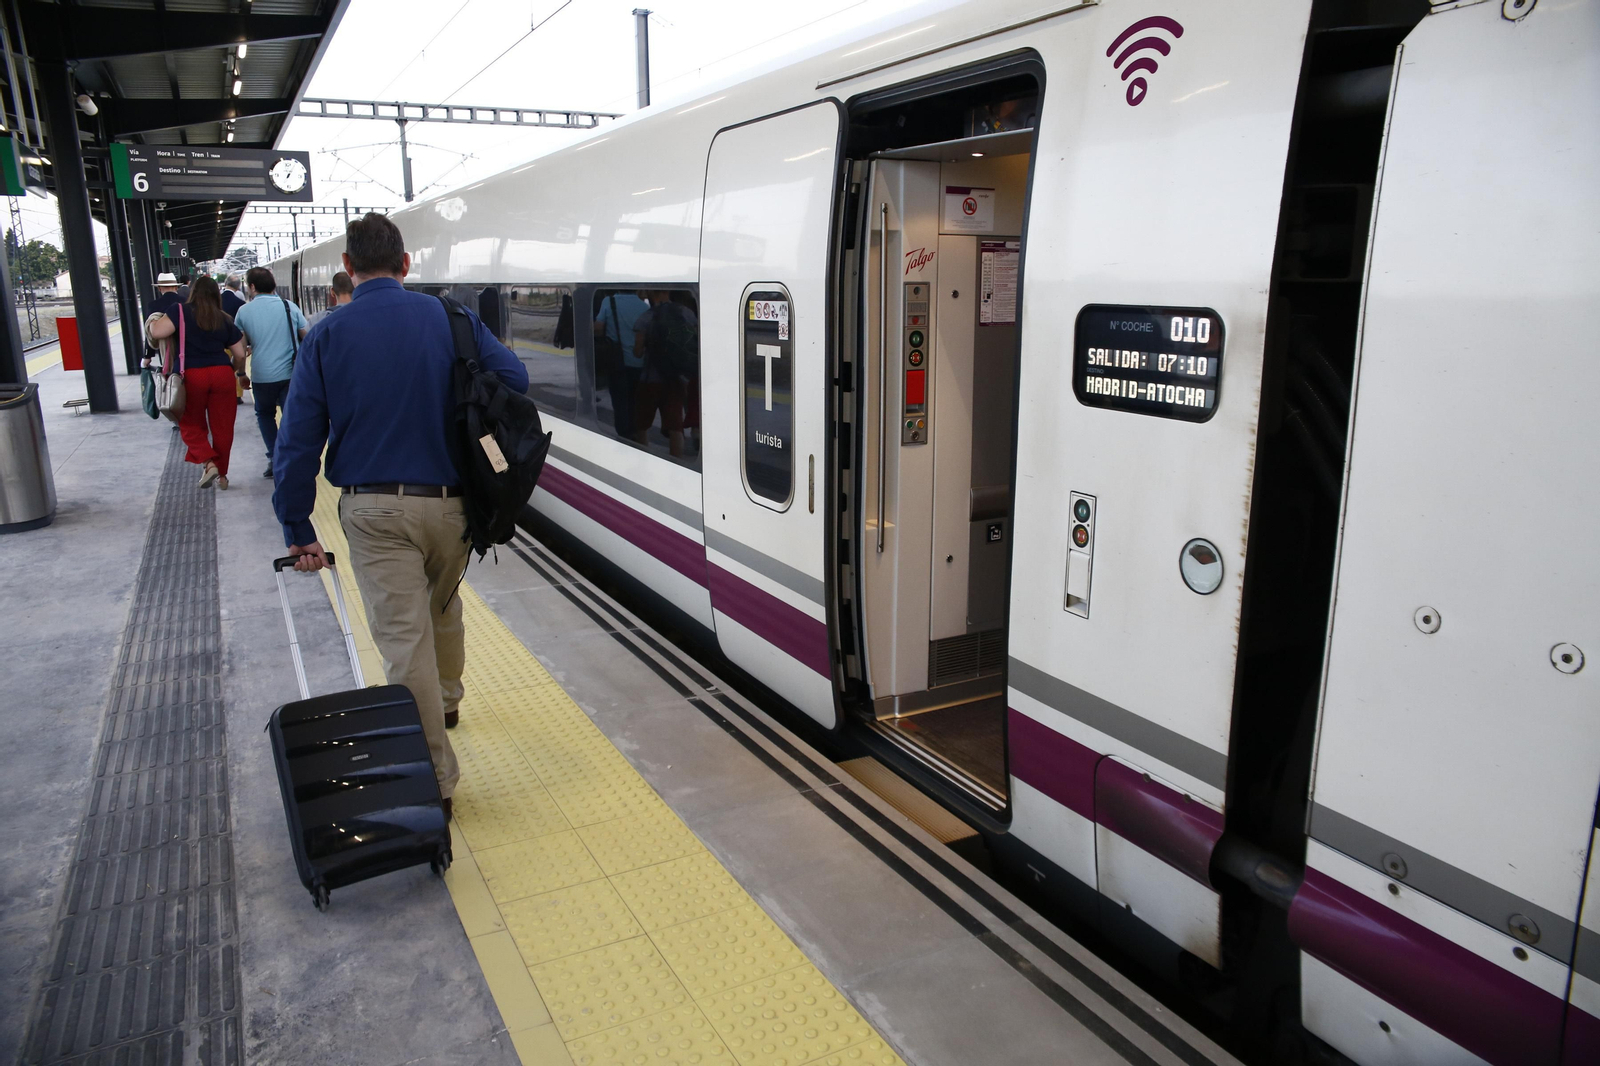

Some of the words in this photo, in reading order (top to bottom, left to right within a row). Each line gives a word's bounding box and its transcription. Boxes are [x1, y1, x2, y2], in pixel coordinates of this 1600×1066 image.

[133, 172, 149, 192] 6
[180, 248, 187, 258] 6
[905, 247, 936, 276] Talgo
[1170, 316, 1211, 343] 010
[1087, 347, 1147, 368] SALIDA:
[1157, 353, 1208, 376] 07:10
[756, 343, 781, 412] T
[1086, 375, 1206, 408] MADRID-ATOCHA
[755, 430, 783, 450] turista
